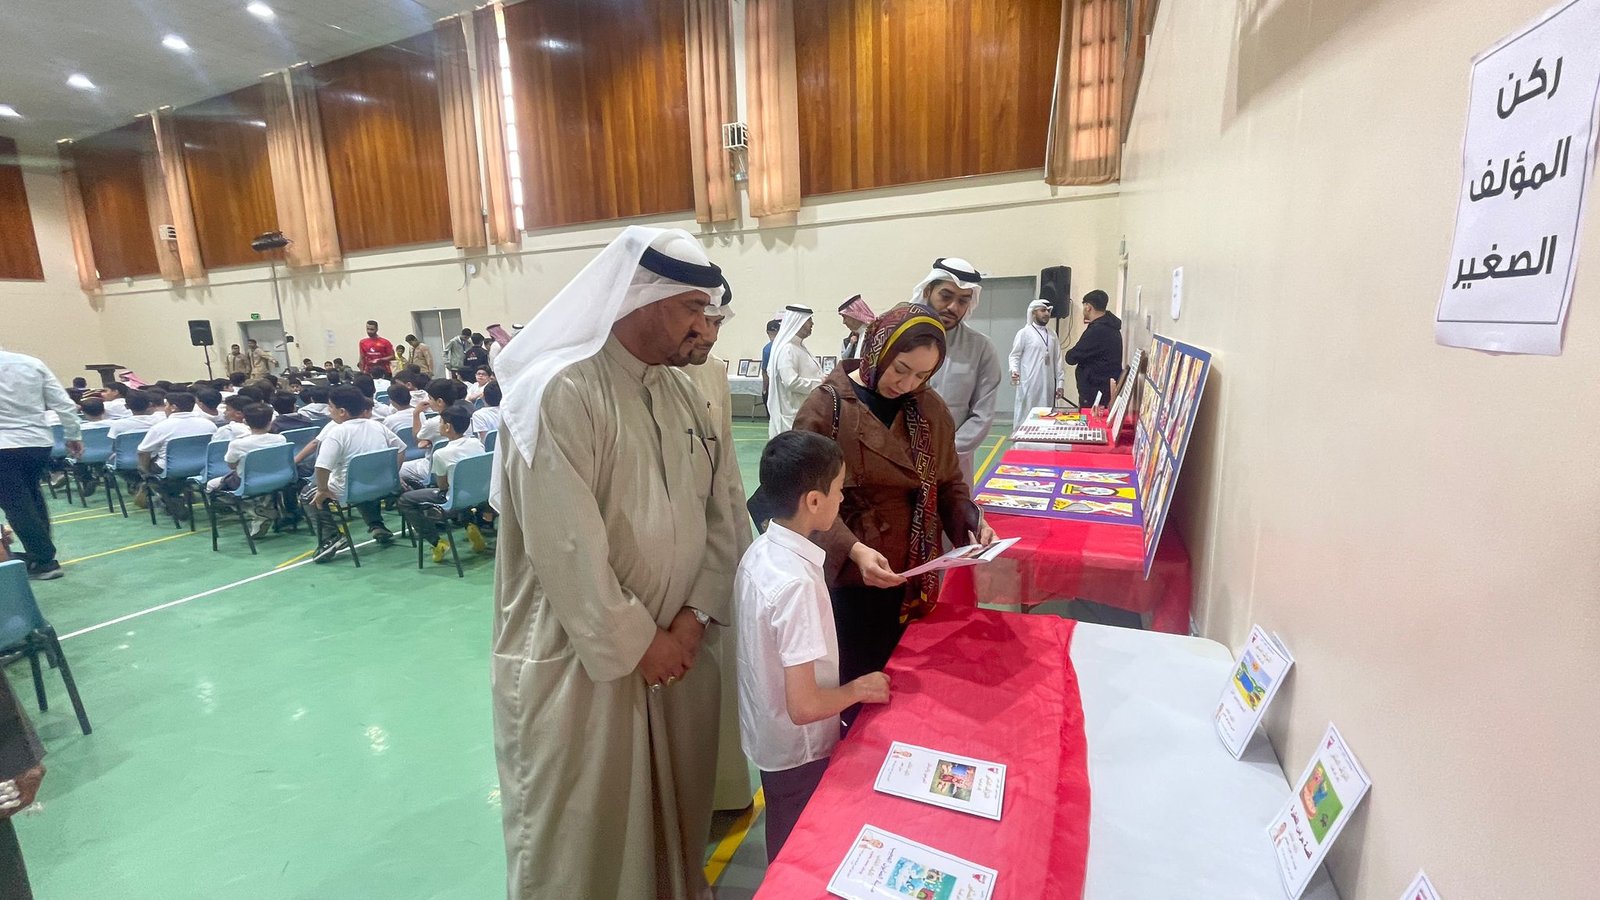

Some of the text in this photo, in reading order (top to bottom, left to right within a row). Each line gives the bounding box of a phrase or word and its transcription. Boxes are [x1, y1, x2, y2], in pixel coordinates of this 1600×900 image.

[1496, 56, 1563, 120] ركن
[1469, 135, 1572, 202] المؤلف
[1451, 234, 1558, 290] الصغير
